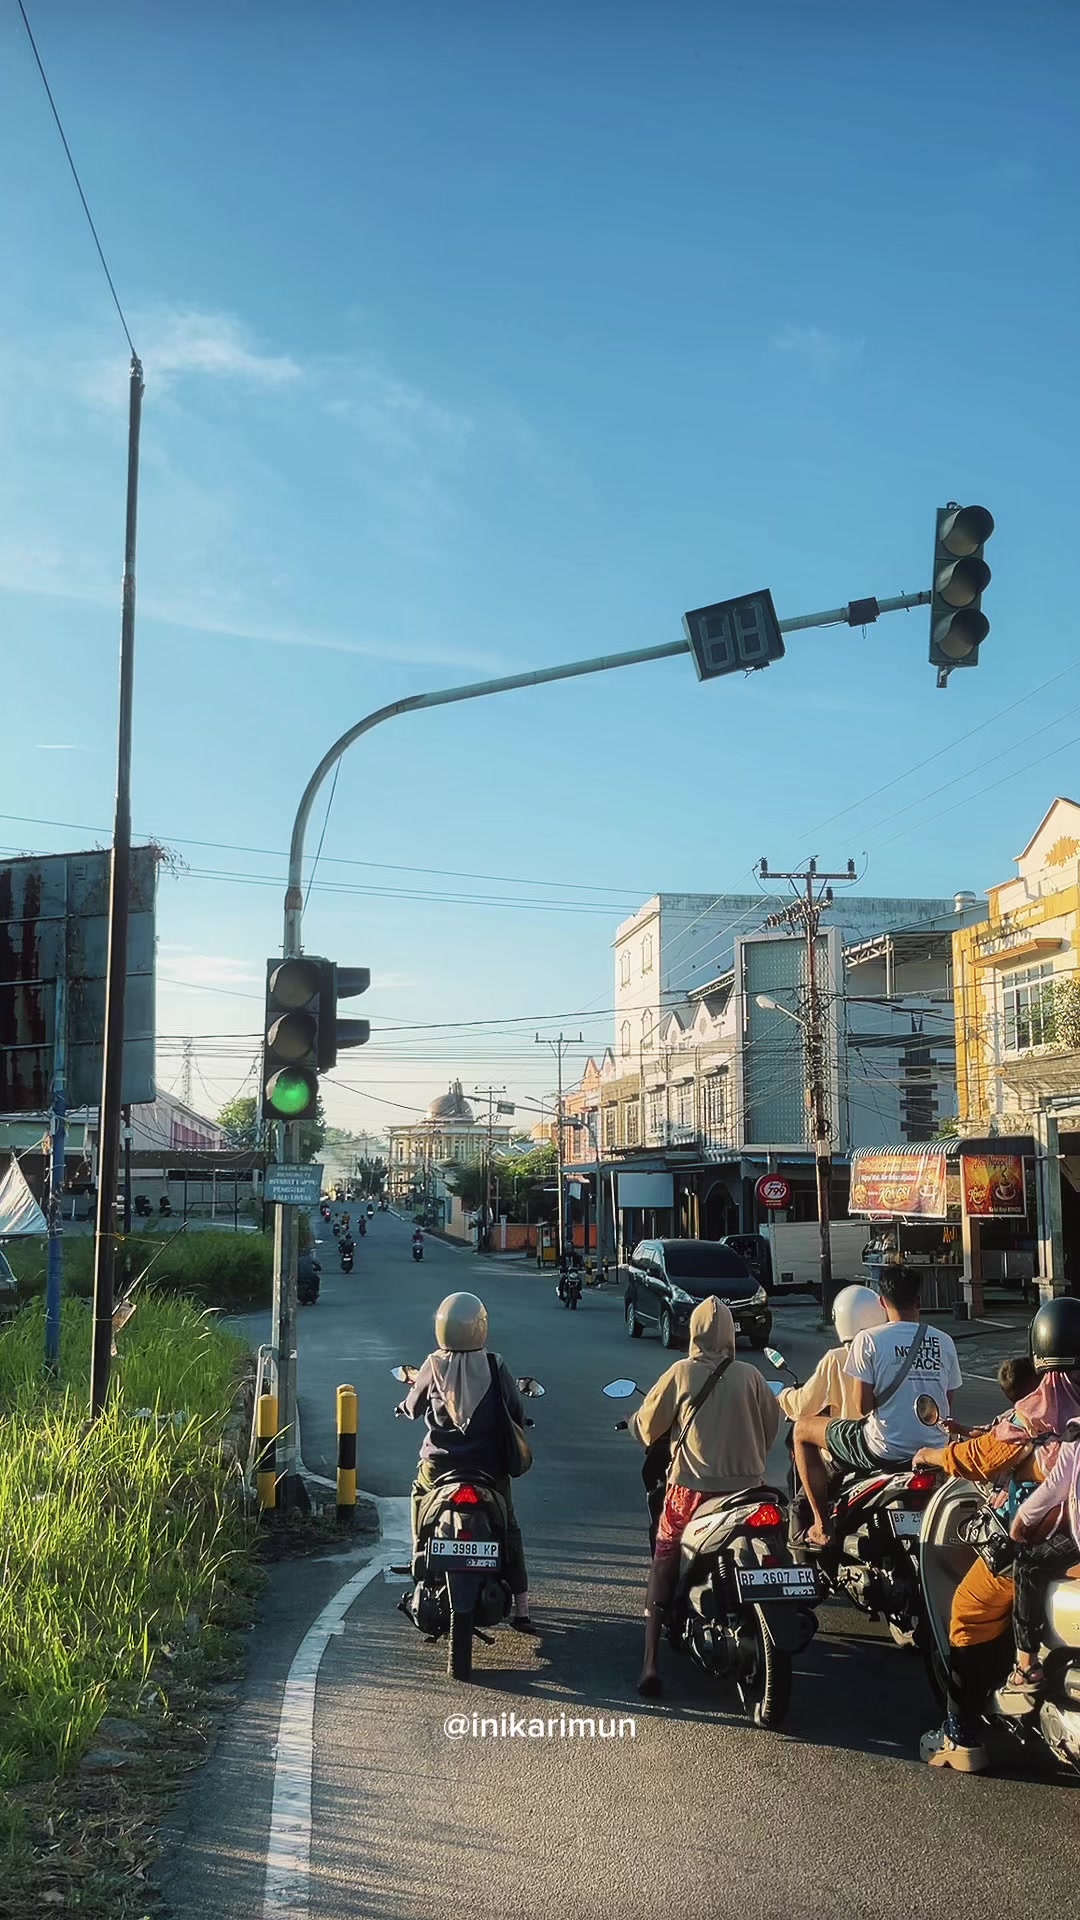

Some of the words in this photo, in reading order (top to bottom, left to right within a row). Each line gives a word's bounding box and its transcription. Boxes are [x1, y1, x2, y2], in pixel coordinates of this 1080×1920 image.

[767, 1187, 785, 1196] 799
[922, 1337, 940, 1348] HE
[913, 1358, 941, 1370] ACE
[894, 1513, 905, 1523] BP
[433, 1542, 446, 1554] BP
[453, 1543, 478, 1555] 3998
[484, 1544, 497, 1556] KP
[741, 1573, 755, 1585] BP
[763, 1571, 790, 1584] 3607
[798, 1570, 814, 1582] FK
